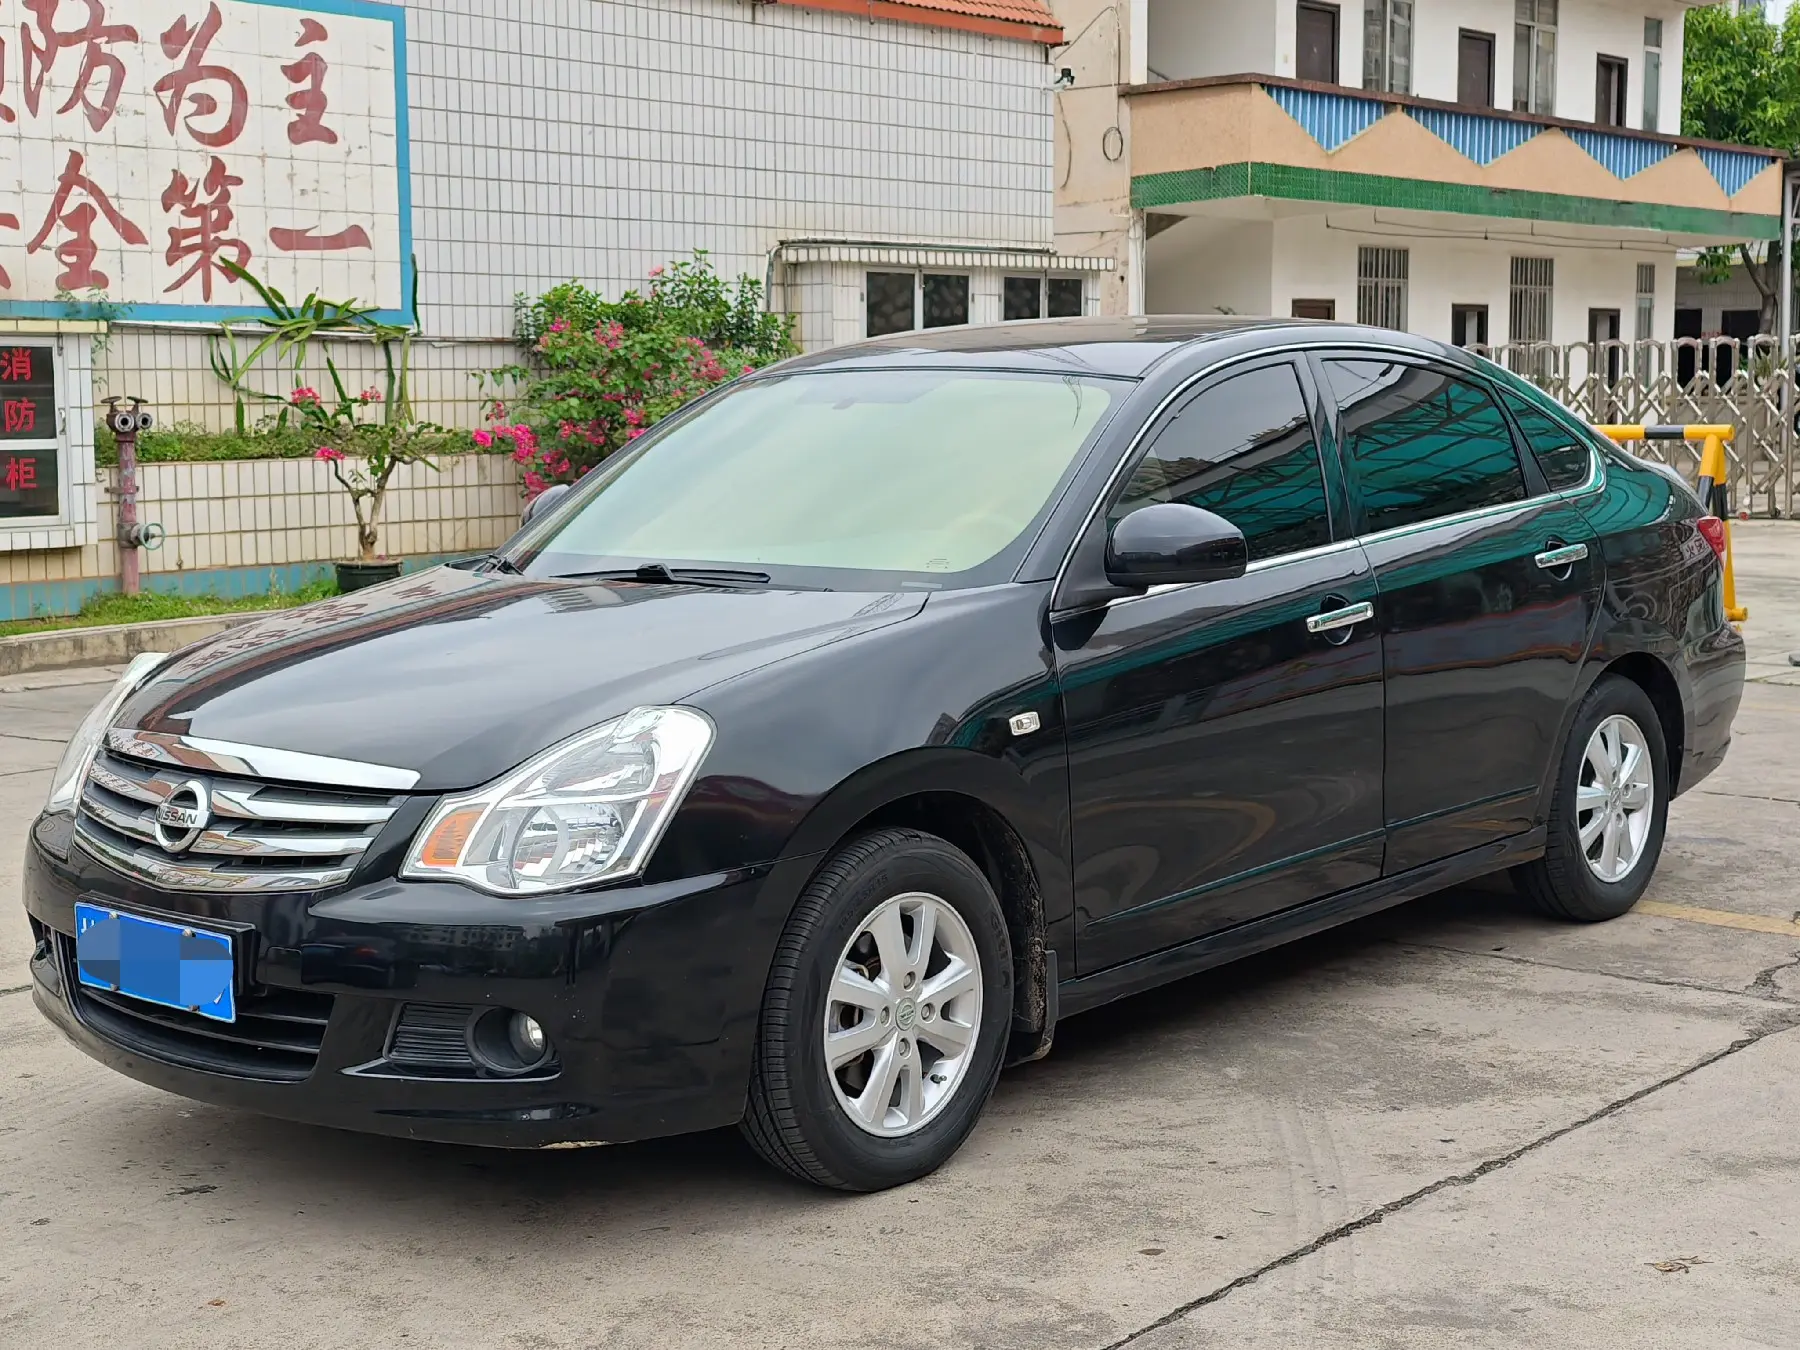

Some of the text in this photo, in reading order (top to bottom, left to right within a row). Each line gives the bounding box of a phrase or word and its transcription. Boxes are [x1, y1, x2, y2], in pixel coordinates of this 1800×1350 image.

[0, 0, 338, 147] 防为主
[0, 150, 372, 303] 全第一
[0, 347, 38, 492] 消防柜
